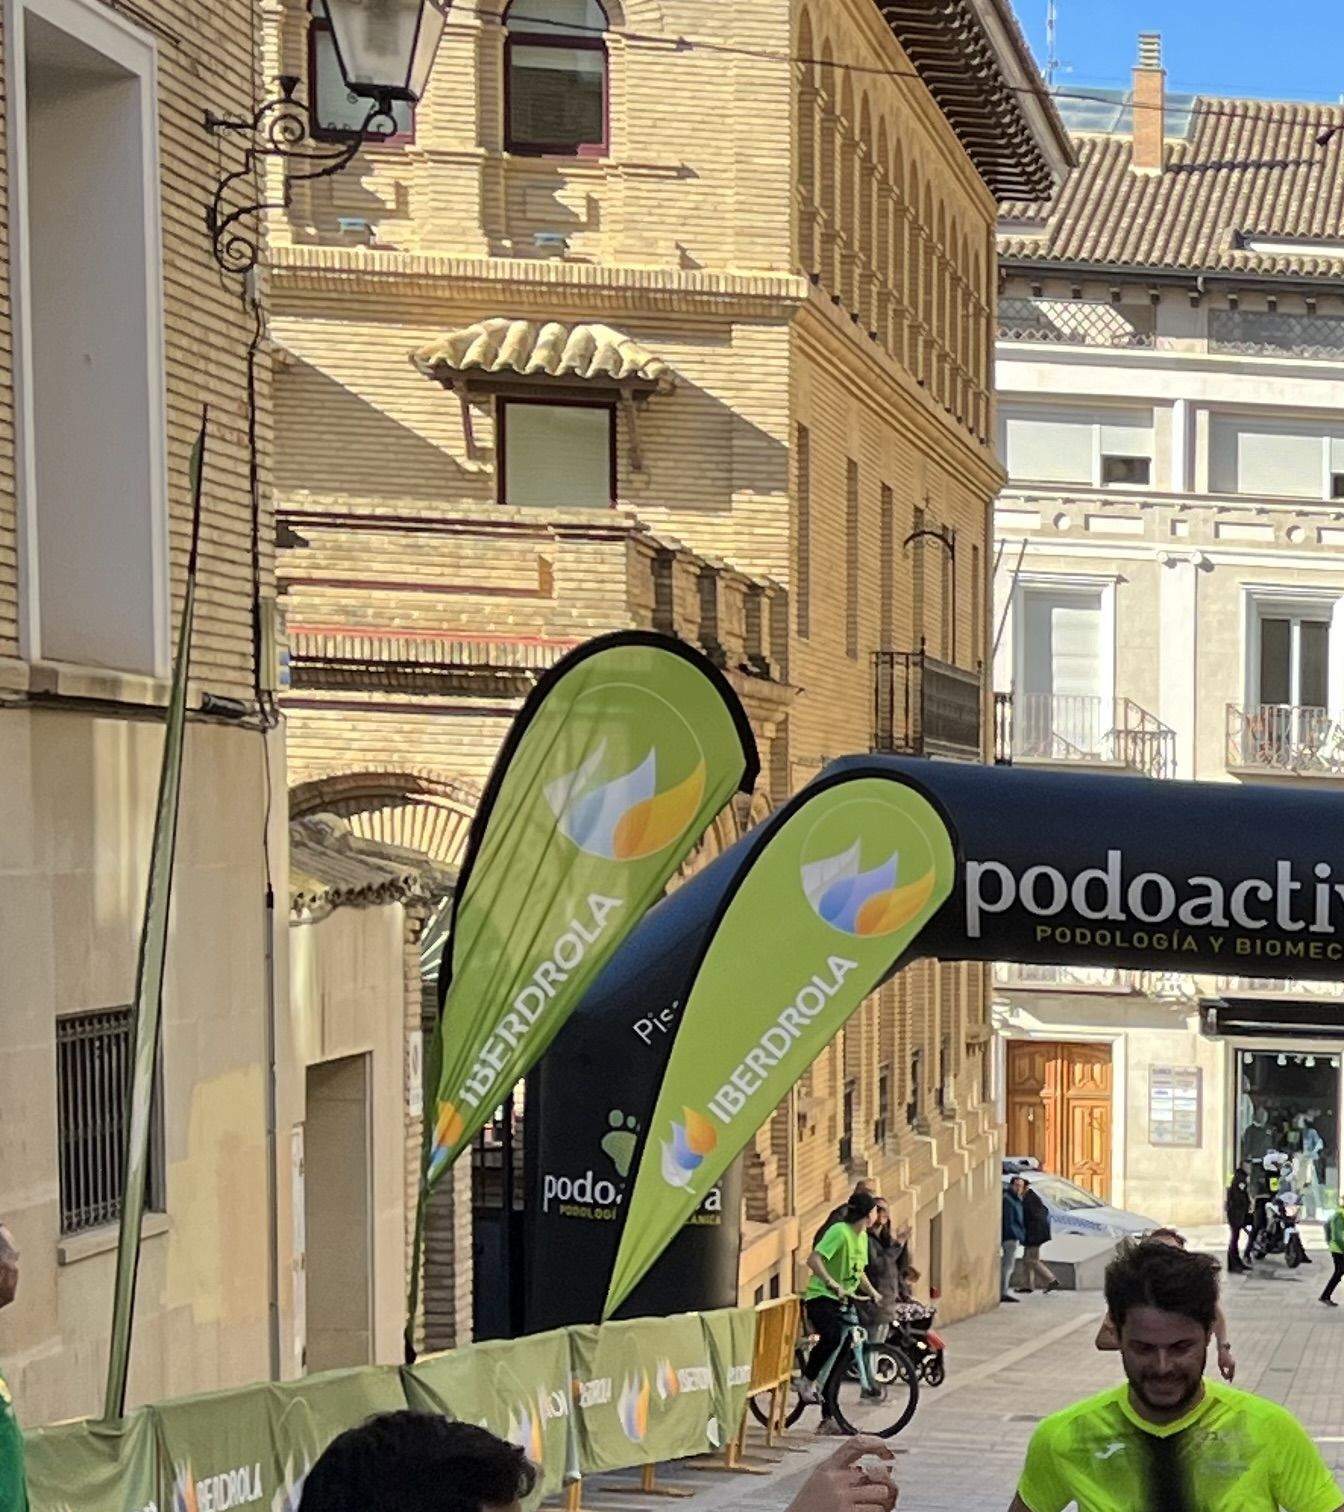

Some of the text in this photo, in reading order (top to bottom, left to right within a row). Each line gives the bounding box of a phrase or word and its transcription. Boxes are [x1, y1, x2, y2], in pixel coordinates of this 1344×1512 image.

[1035, 926, 1198, 953] PODOLOGÍA
[1211, 936, 1223, 955] Y
[459, 891, 624, 1109] IBERDROLA
[632, 999, 680, 1045] Pis
[706, 954, 859, 1125] IBERDROLA
